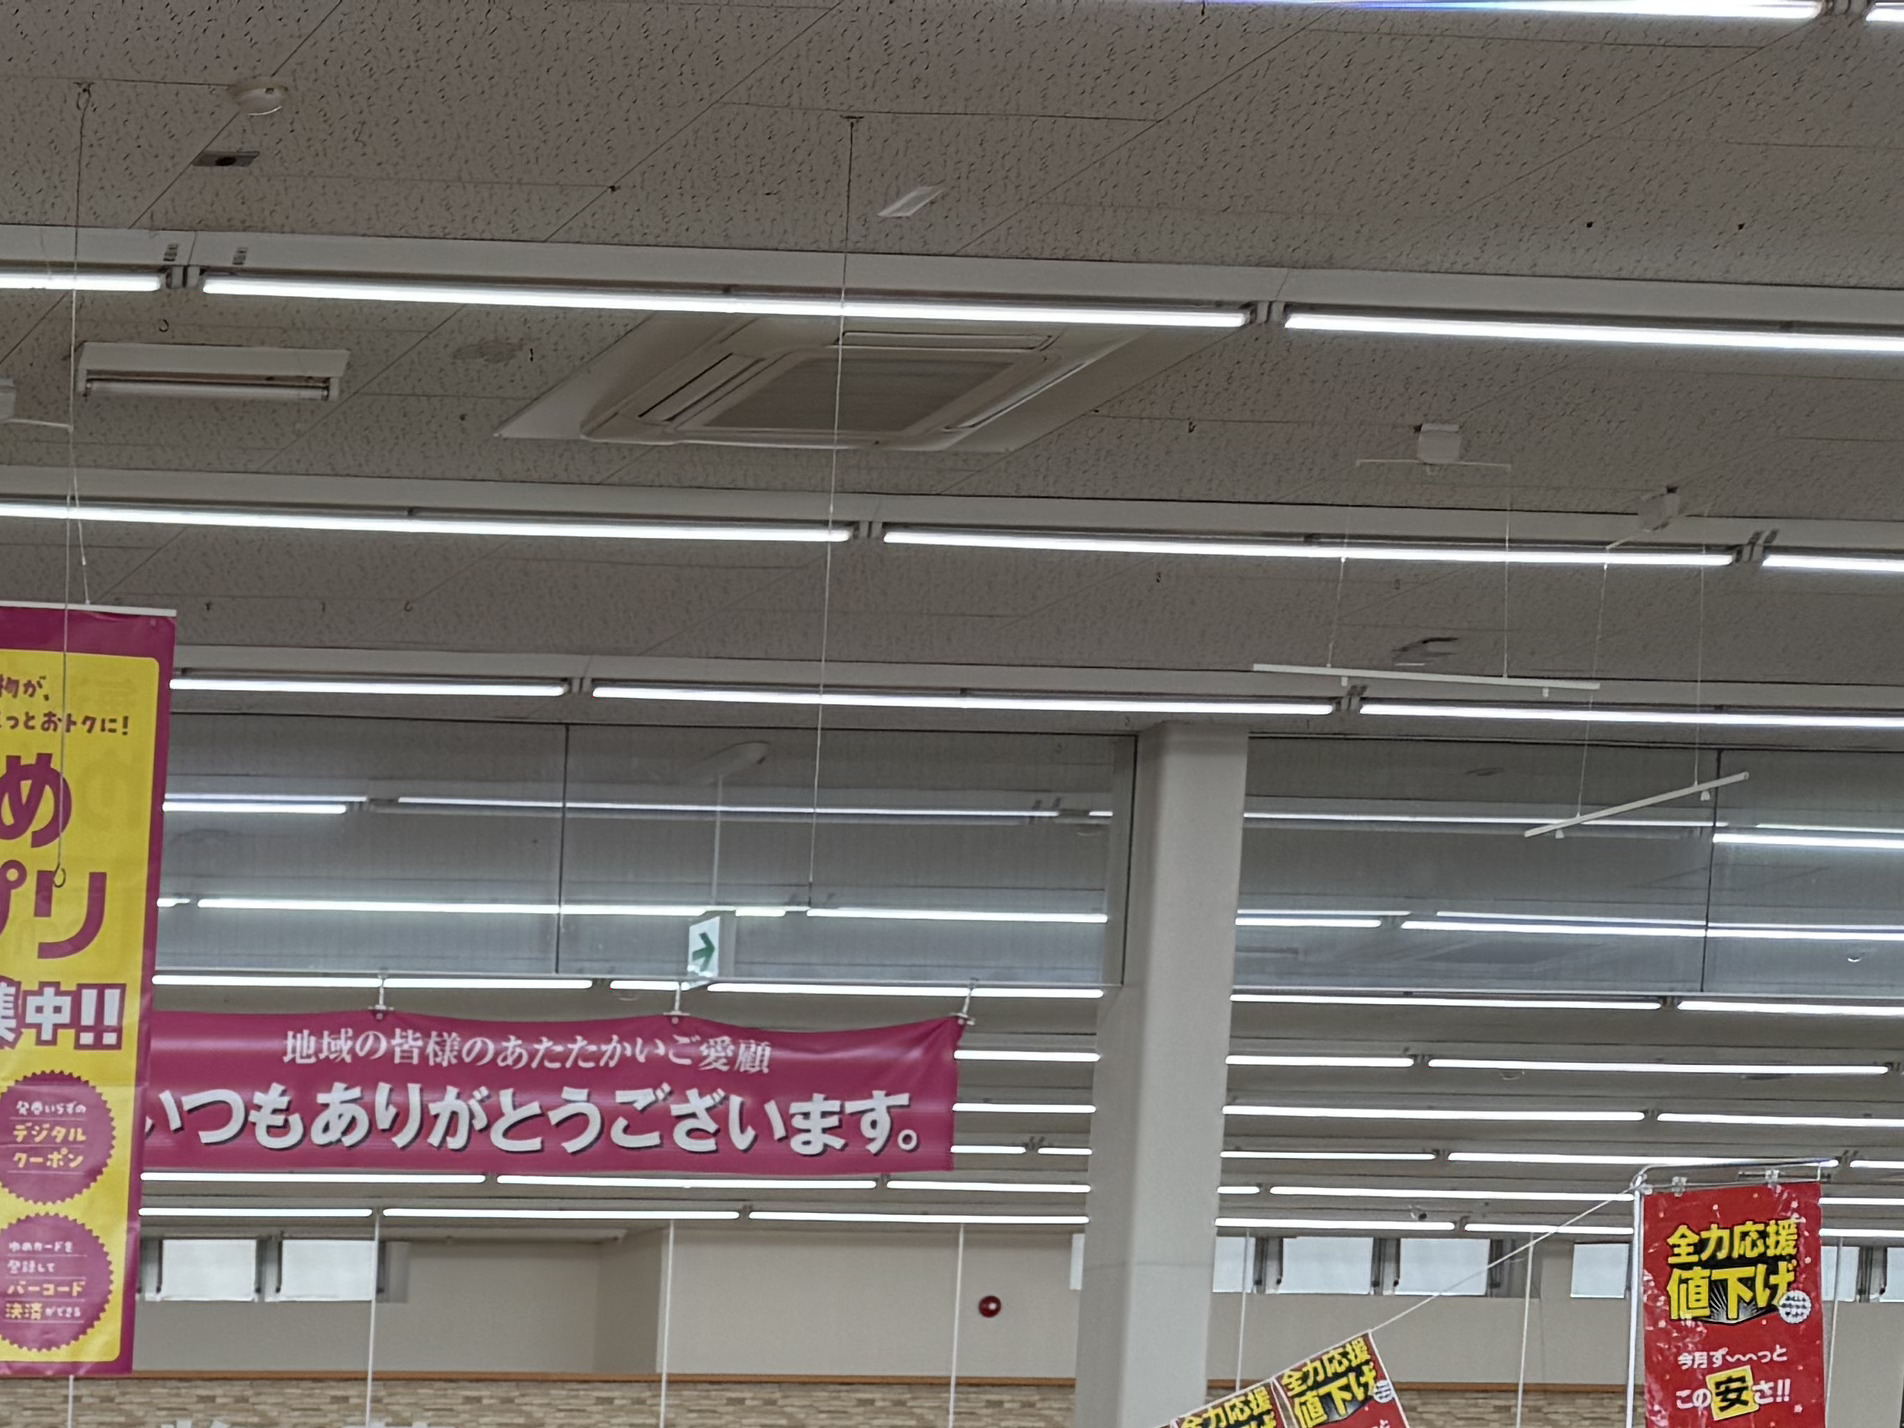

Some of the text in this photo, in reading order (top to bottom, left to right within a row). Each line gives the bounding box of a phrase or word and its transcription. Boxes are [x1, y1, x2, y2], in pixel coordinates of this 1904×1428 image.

[283, 1027, 774, 1077] 地域の皆様のあたたかいご愛顧
[12, 1122, 87, 1144] デジタル
[147, 1081, 923, 1157] いつもありがとうございます。
[12, 1147, 85, 1170] クーポン
[1666, 1219, 1799, 1264] 全力応援
[6, 1280, 86, 1297] バーコード
[1281, 1338, 1371, 1395] 全力応援
